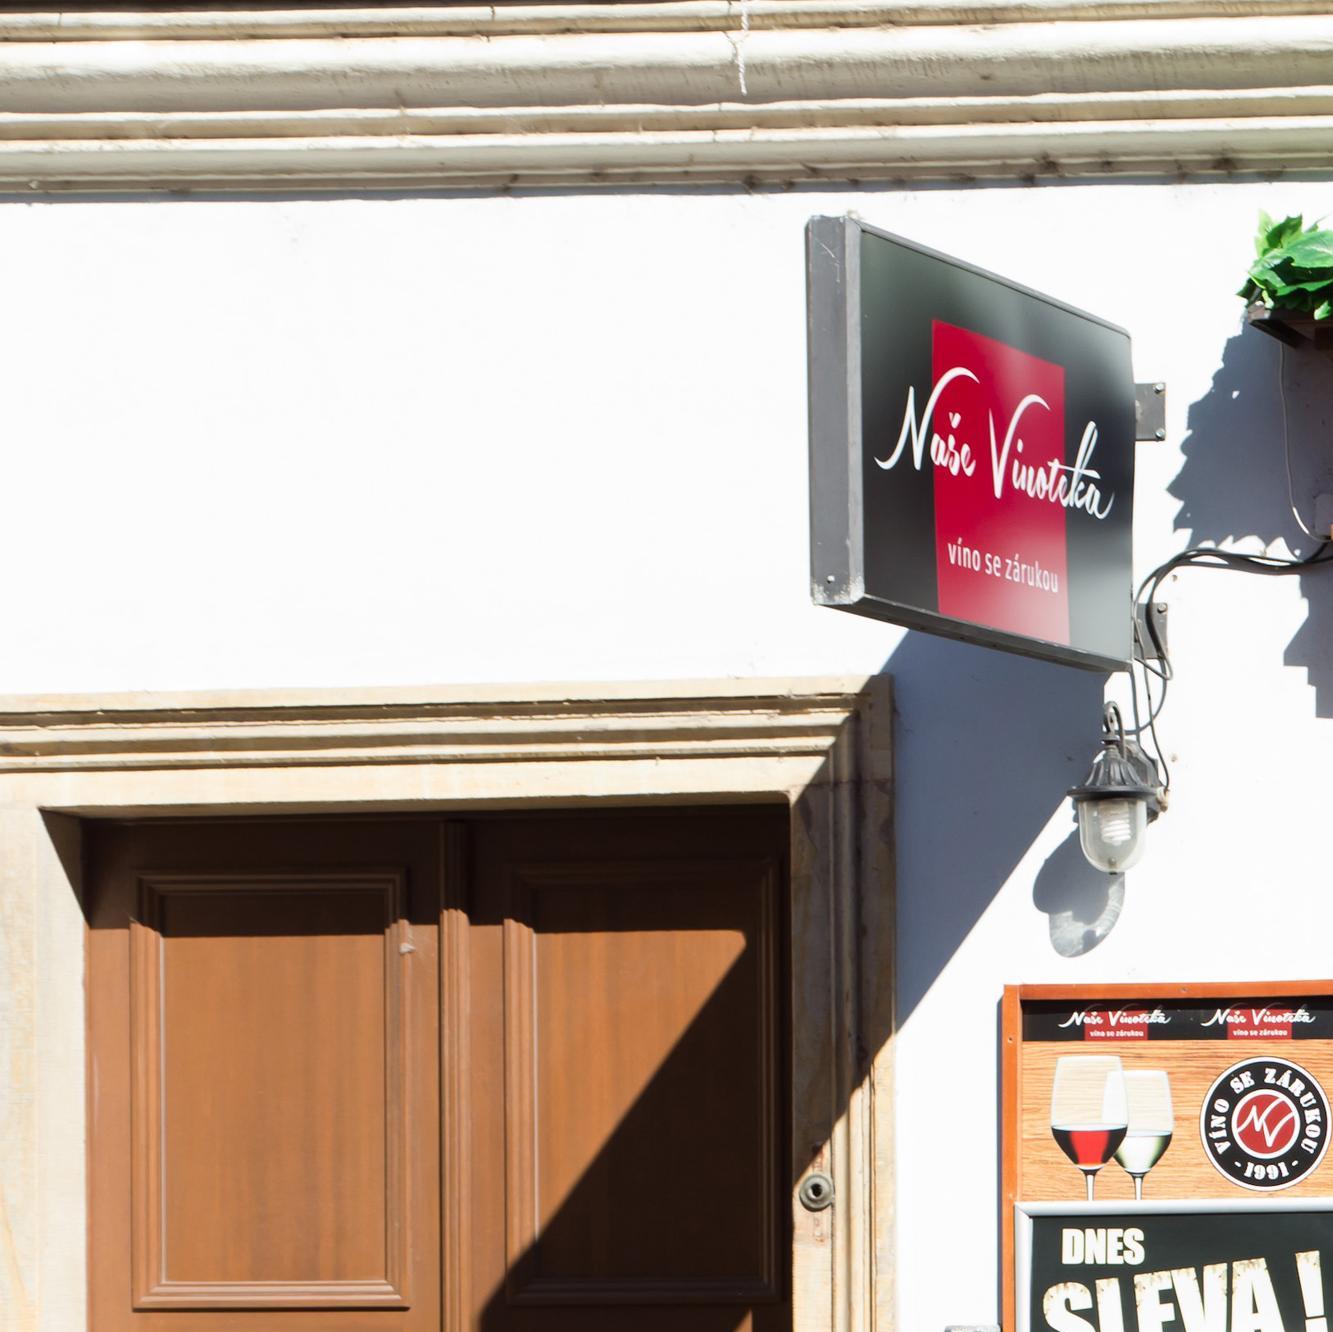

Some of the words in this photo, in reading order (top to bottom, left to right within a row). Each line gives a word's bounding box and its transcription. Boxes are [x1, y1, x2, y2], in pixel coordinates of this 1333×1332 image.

[873, 366, 980, 477] Naše
[988, 393, 1115, 520] Vinoteka
[947, 537, 981, 573] víno
[985, 555, 1001, 577] se
[1004, 553, 1059, 593] zárukou
[1058, 1004, 1103, 1028] Naše
[1108, 1003, 1171, 1027] Vinoteka
[1200, 1003, 1247, 1027] Naše
[1252, 1003, 1316, 1026] Vinoteka
[1208, 1098, 1231, 1155] VÍNO
[1230, 1071, 1255, 1094] SE
[1264, 1067, 1321, 1154] ZÁRUKOU
[1244, 1161, 1290, 1180] 1991
[1061, 1227, 1145, 1266] DNES
